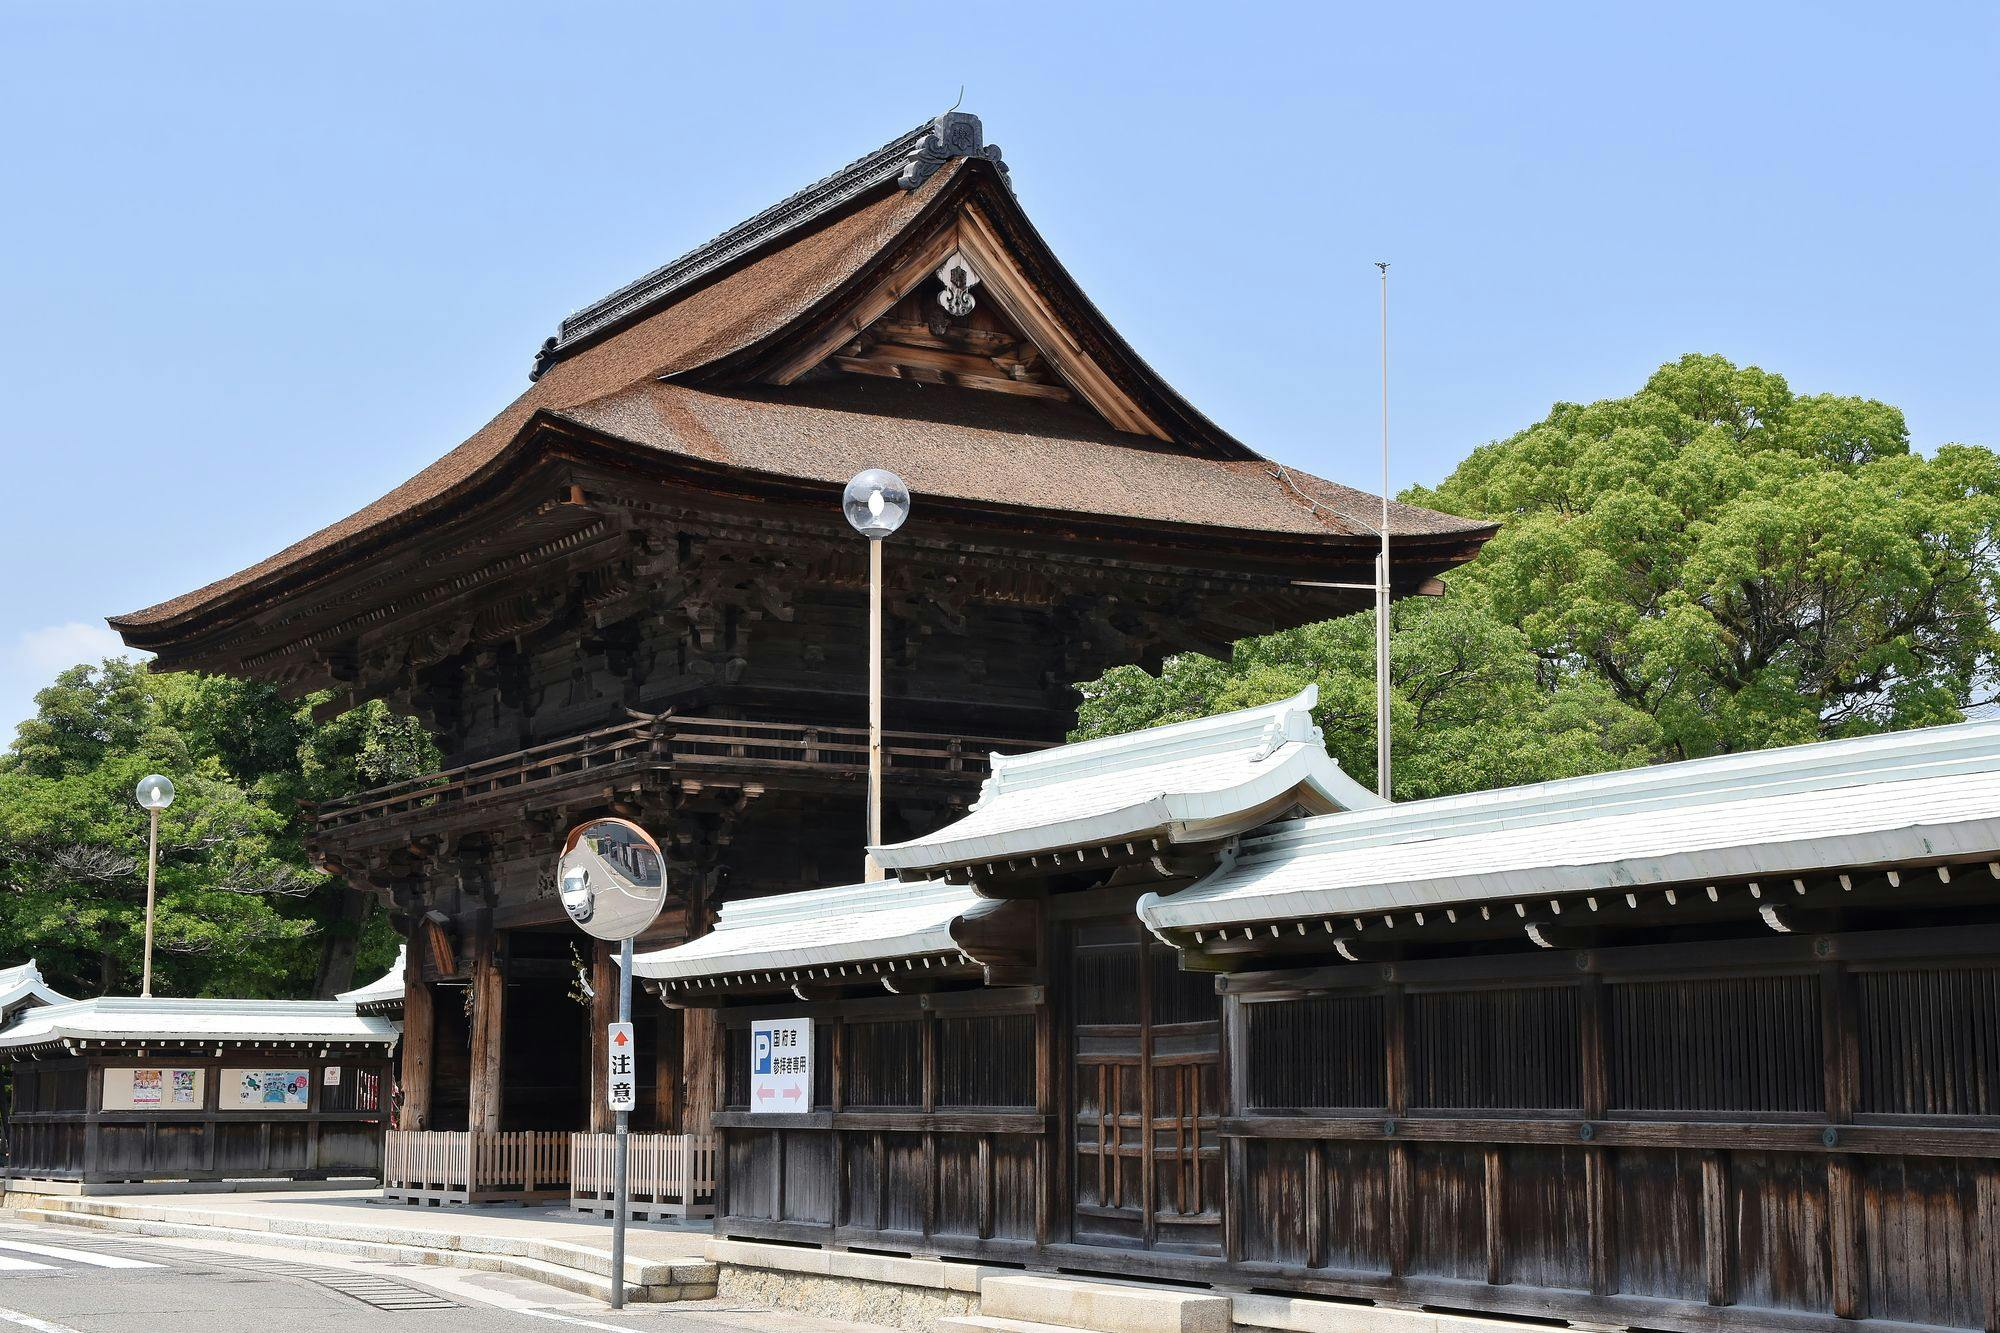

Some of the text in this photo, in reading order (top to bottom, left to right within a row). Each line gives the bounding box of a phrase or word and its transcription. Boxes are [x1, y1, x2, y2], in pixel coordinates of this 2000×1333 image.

[773, 1029, 797, 1047] 国府宮
[756, 1035, 770, 1071] P
[773, 1056, 806, 1075] 参拝者専用
[612, 1054, 632, 1104] 注意
